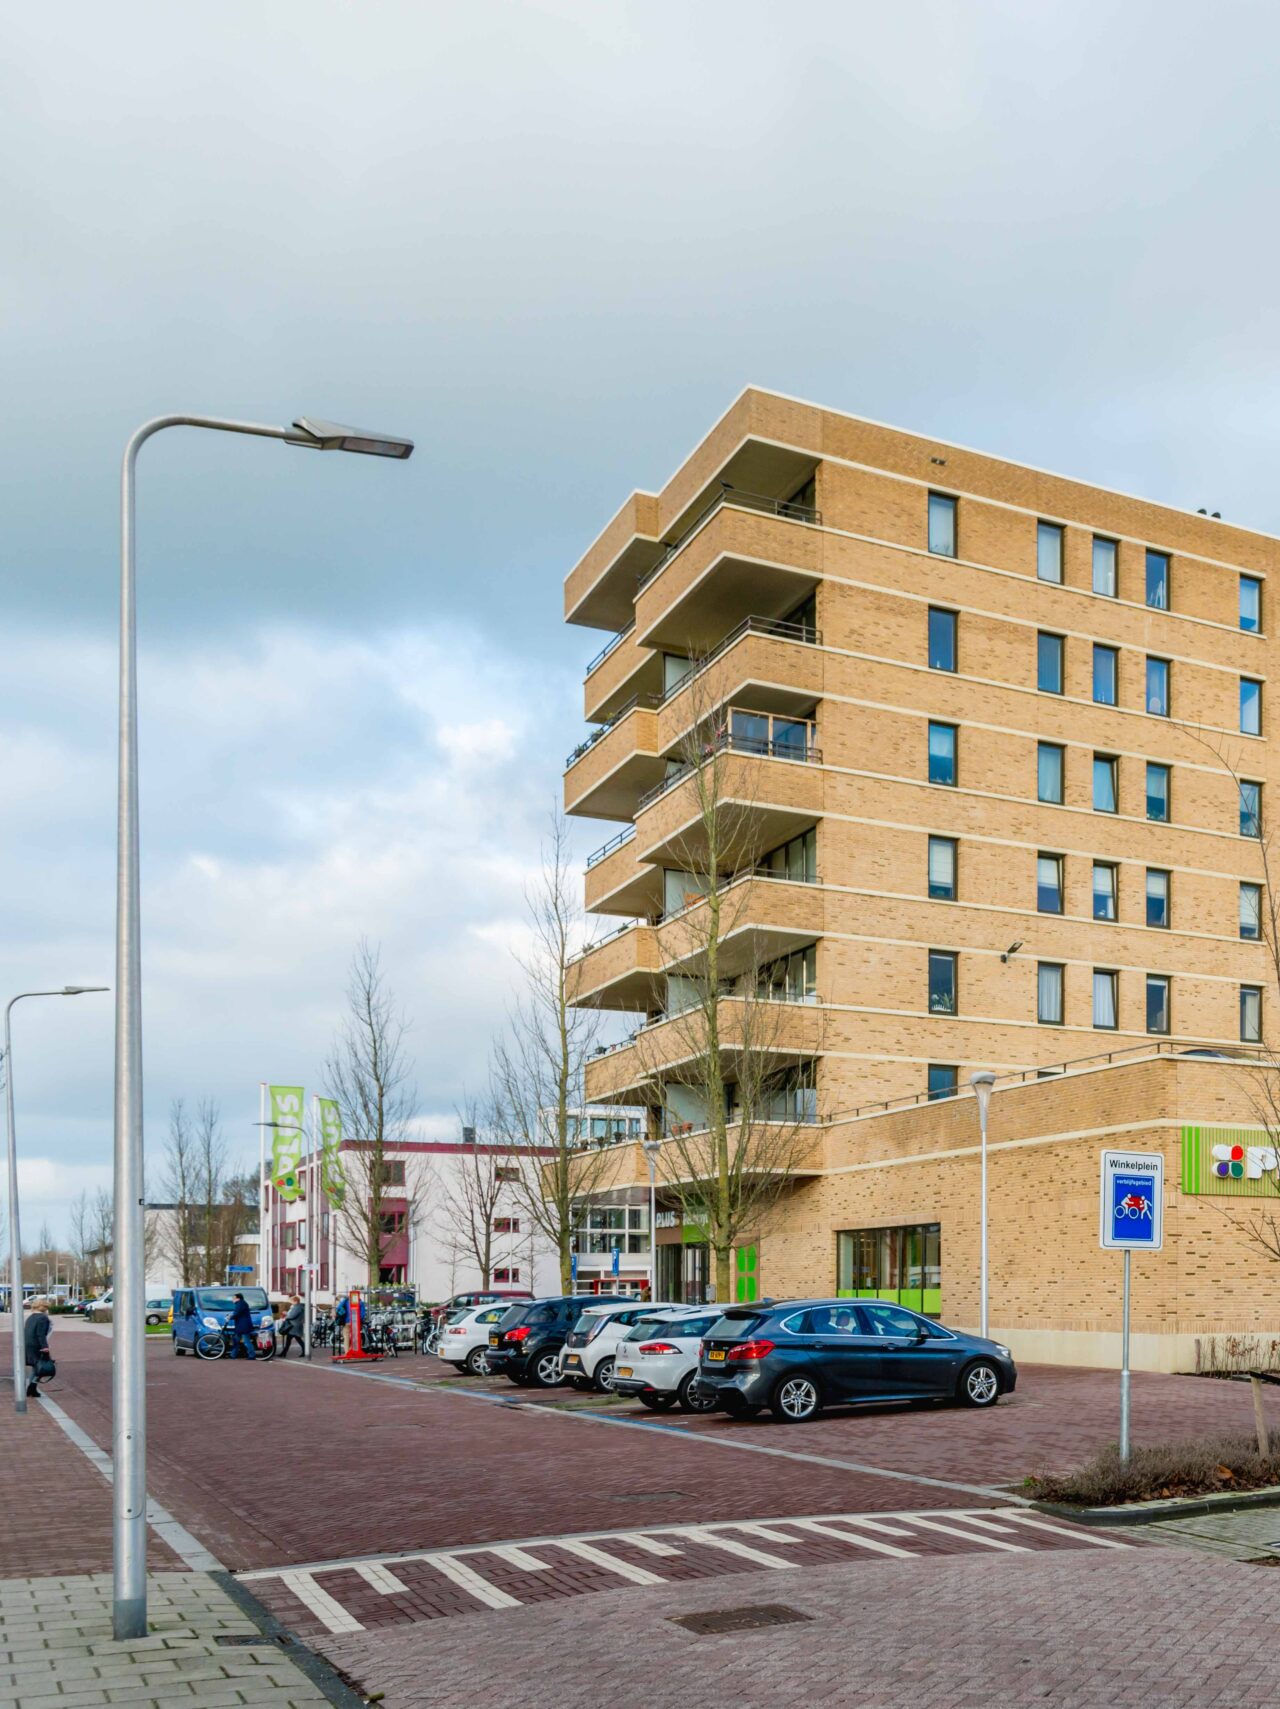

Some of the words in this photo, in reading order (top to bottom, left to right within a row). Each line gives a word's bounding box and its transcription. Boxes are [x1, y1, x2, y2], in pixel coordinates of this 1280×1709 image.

[276, 1094, 299, 1177] PLUS
[1109, 1160, 1158, 1171] Winkelplein
[656, 1210, 676, 1228] PLUS
